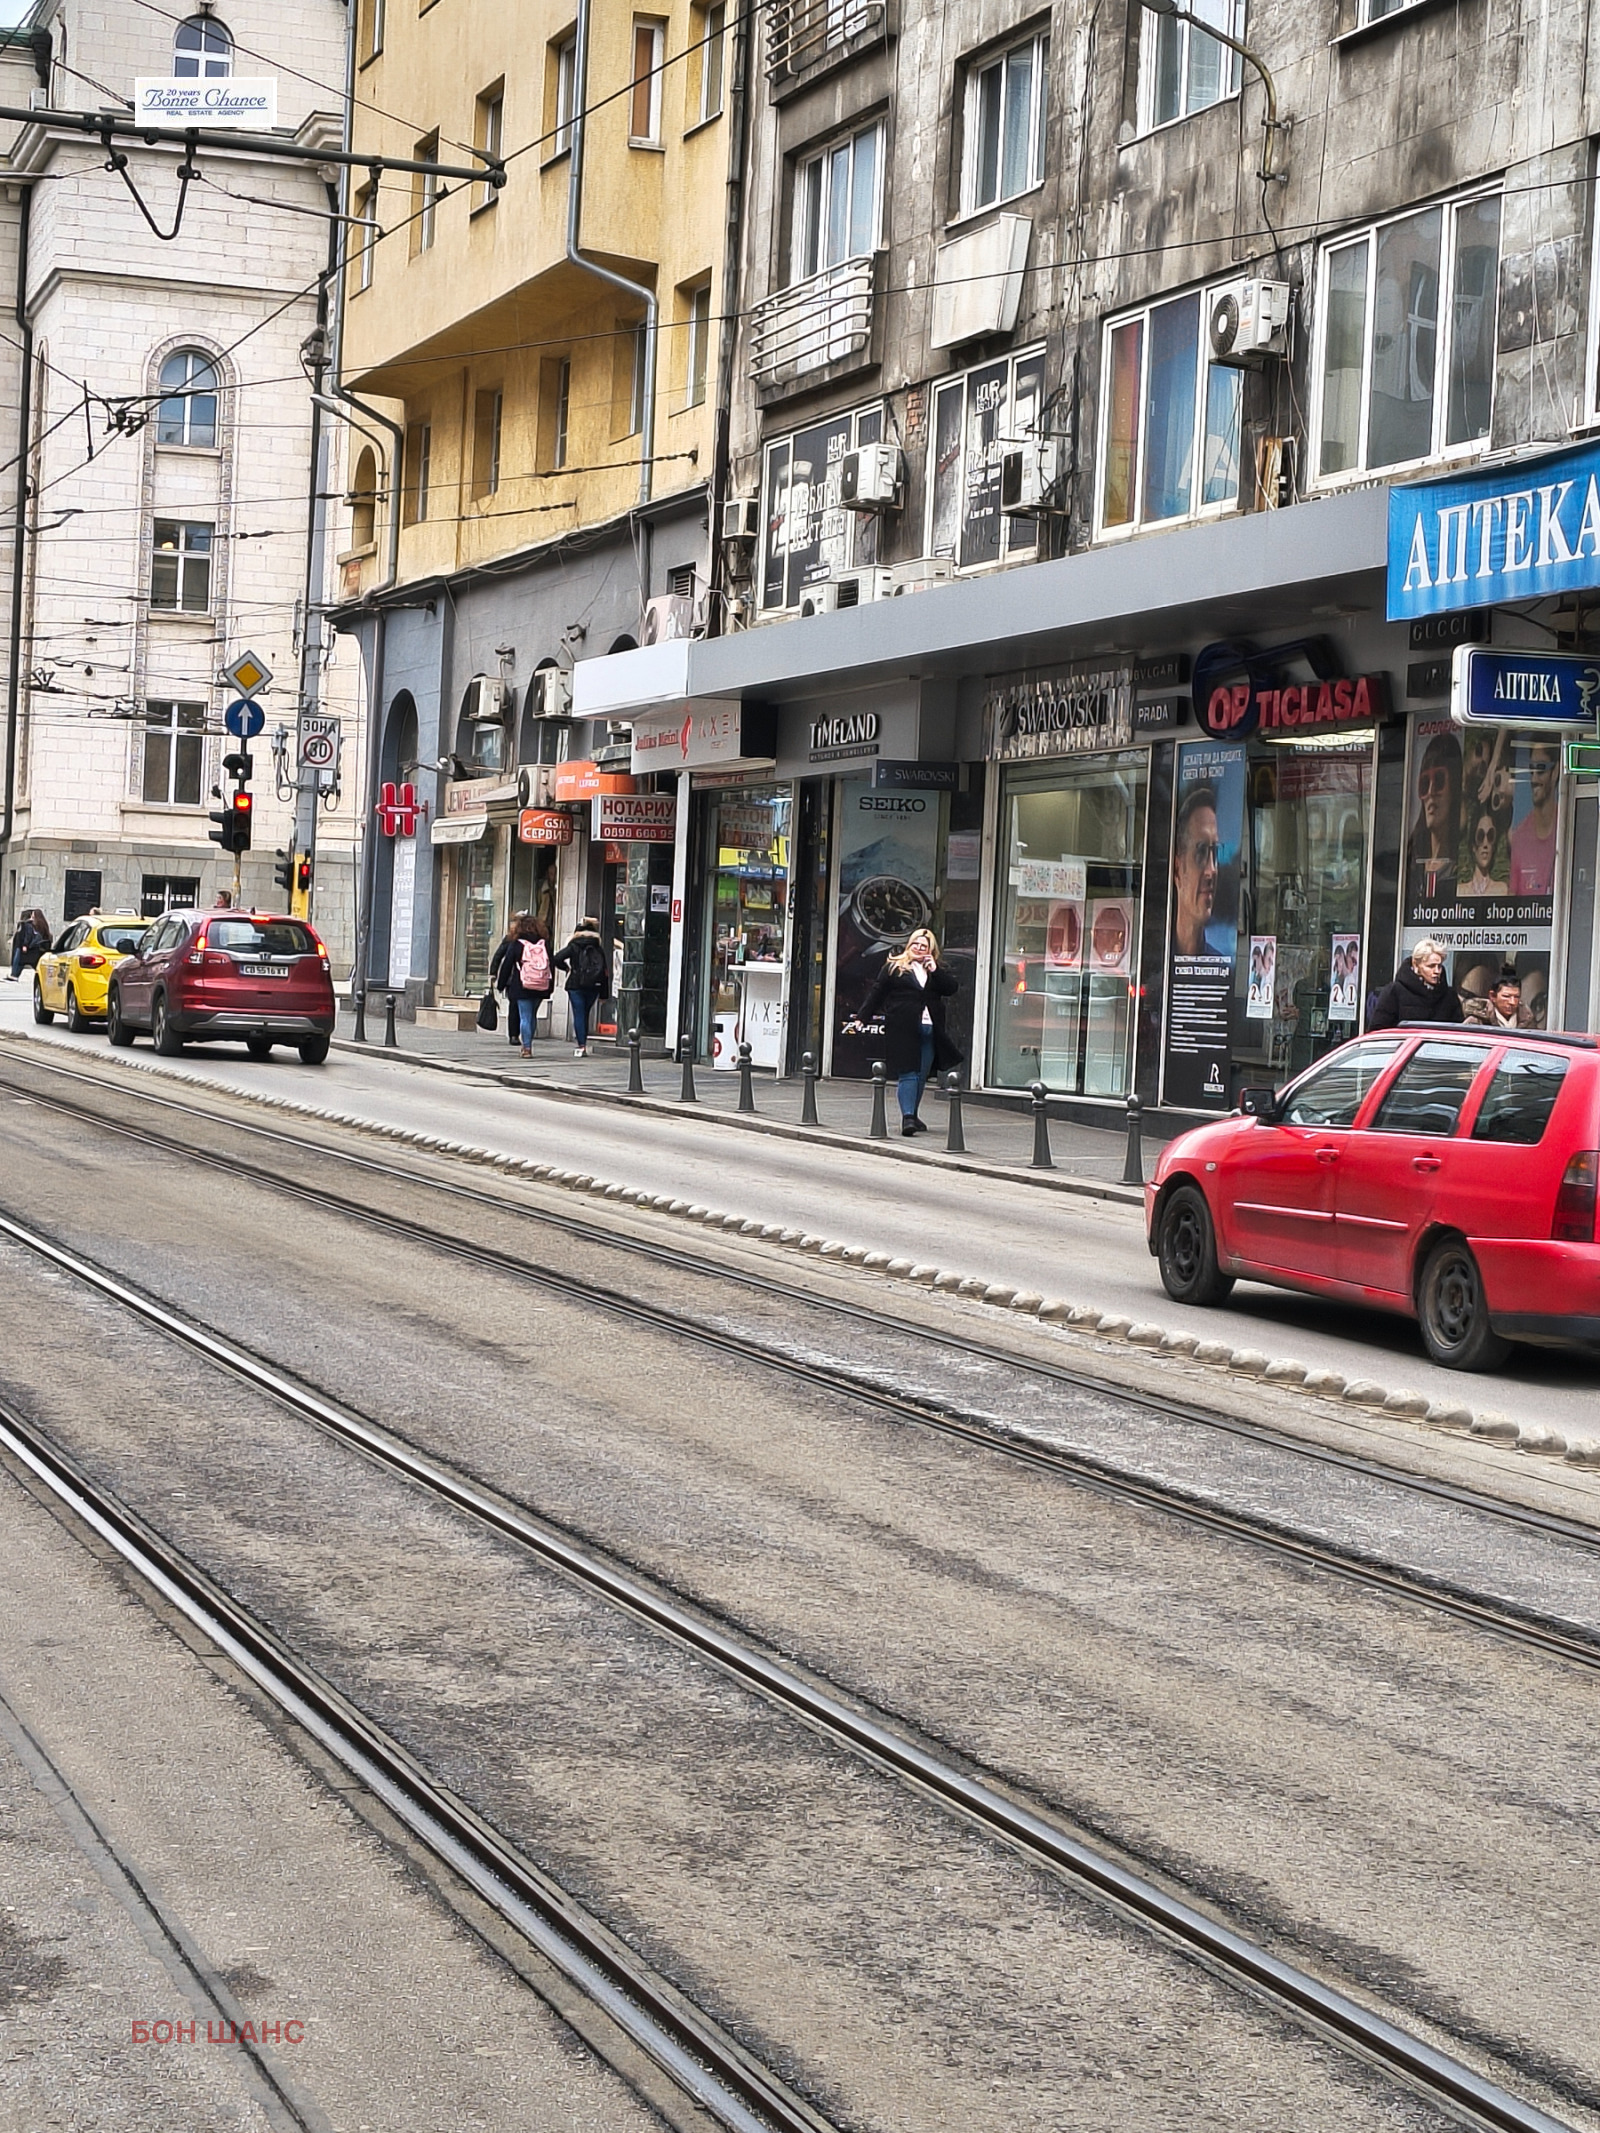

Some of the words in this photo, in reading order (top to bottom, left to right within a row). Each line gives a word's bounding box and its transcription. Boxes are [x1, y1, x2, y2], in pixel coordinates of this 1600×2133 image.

[1403, 473, 1600, 591] АПТЕКА
[1412, 616, 1468, 642] GUCCI
[1134, 662, 1178, 681] BVLGARI
[1494, 671, 1561, 703] АПТЕКА
[1018, 692, 1101, 734] SWAROVSKI
[1138, 704, 1169, 722] PRADA
[303, 720, 336, 734] ЗОНА
[309, 742, 328, 758] 30
[895, 769, 955, 782] SWAROVSKI
[603, 800, 676, 817] НОТАРИУ
[859, 796, 926, 812] SEIKO
[544, 818, 570, 829] GSM
[523, 828, 570, 840] СЕРВИЗ
[1413, 903, 1439, 923] shop
[1441, 903, 1475, 920] online
[1486, 902, 1514, 922] shop
[1517, 902, 1552, 919] online
[1430, 929, 1528, 948] www.opticlasa.com
